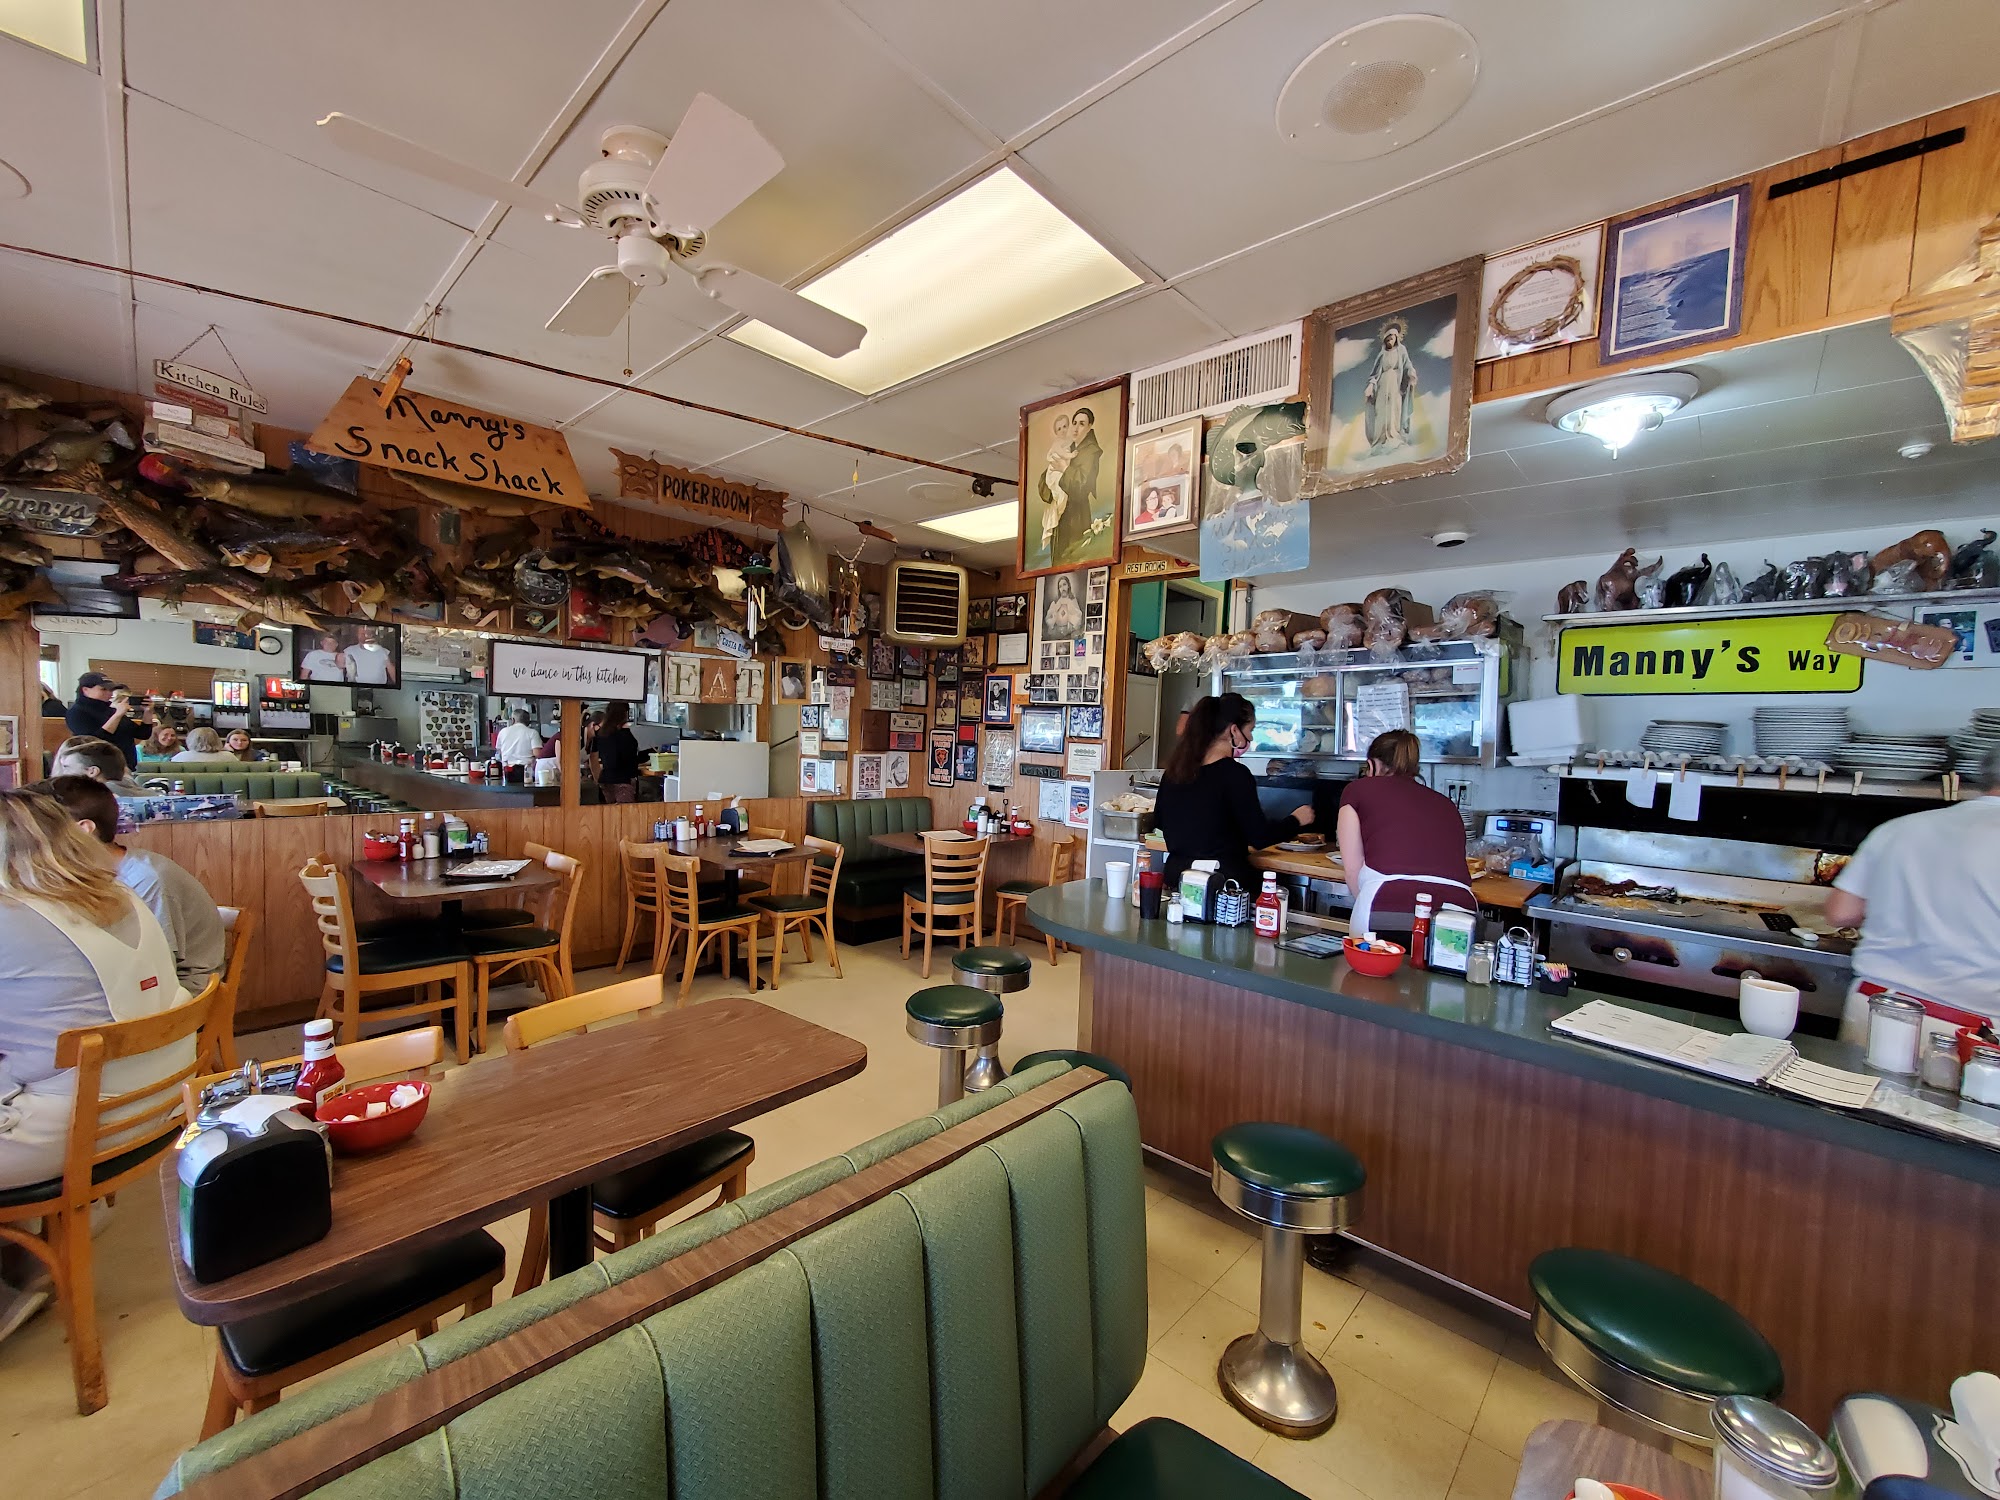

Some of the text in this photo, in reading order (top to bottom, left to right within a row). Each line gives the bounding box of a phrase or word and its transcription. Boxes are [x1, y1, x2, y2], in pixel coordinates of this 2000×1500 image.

[160, 362, 265, 411] Kitchen Rules
[373, 387, 525, 451] Manny's
[334, 426, 564, 496] Snack Shack
[662, 474, 750, 514] POKER ROOM
[1126, 561, 1166, 573] REST ROOMS
[513, 661, 629, 685] we dance in this kitchen
[670, 660, 763, 698] EAT
[1573, 639, 1842, 679] Manny's Way
